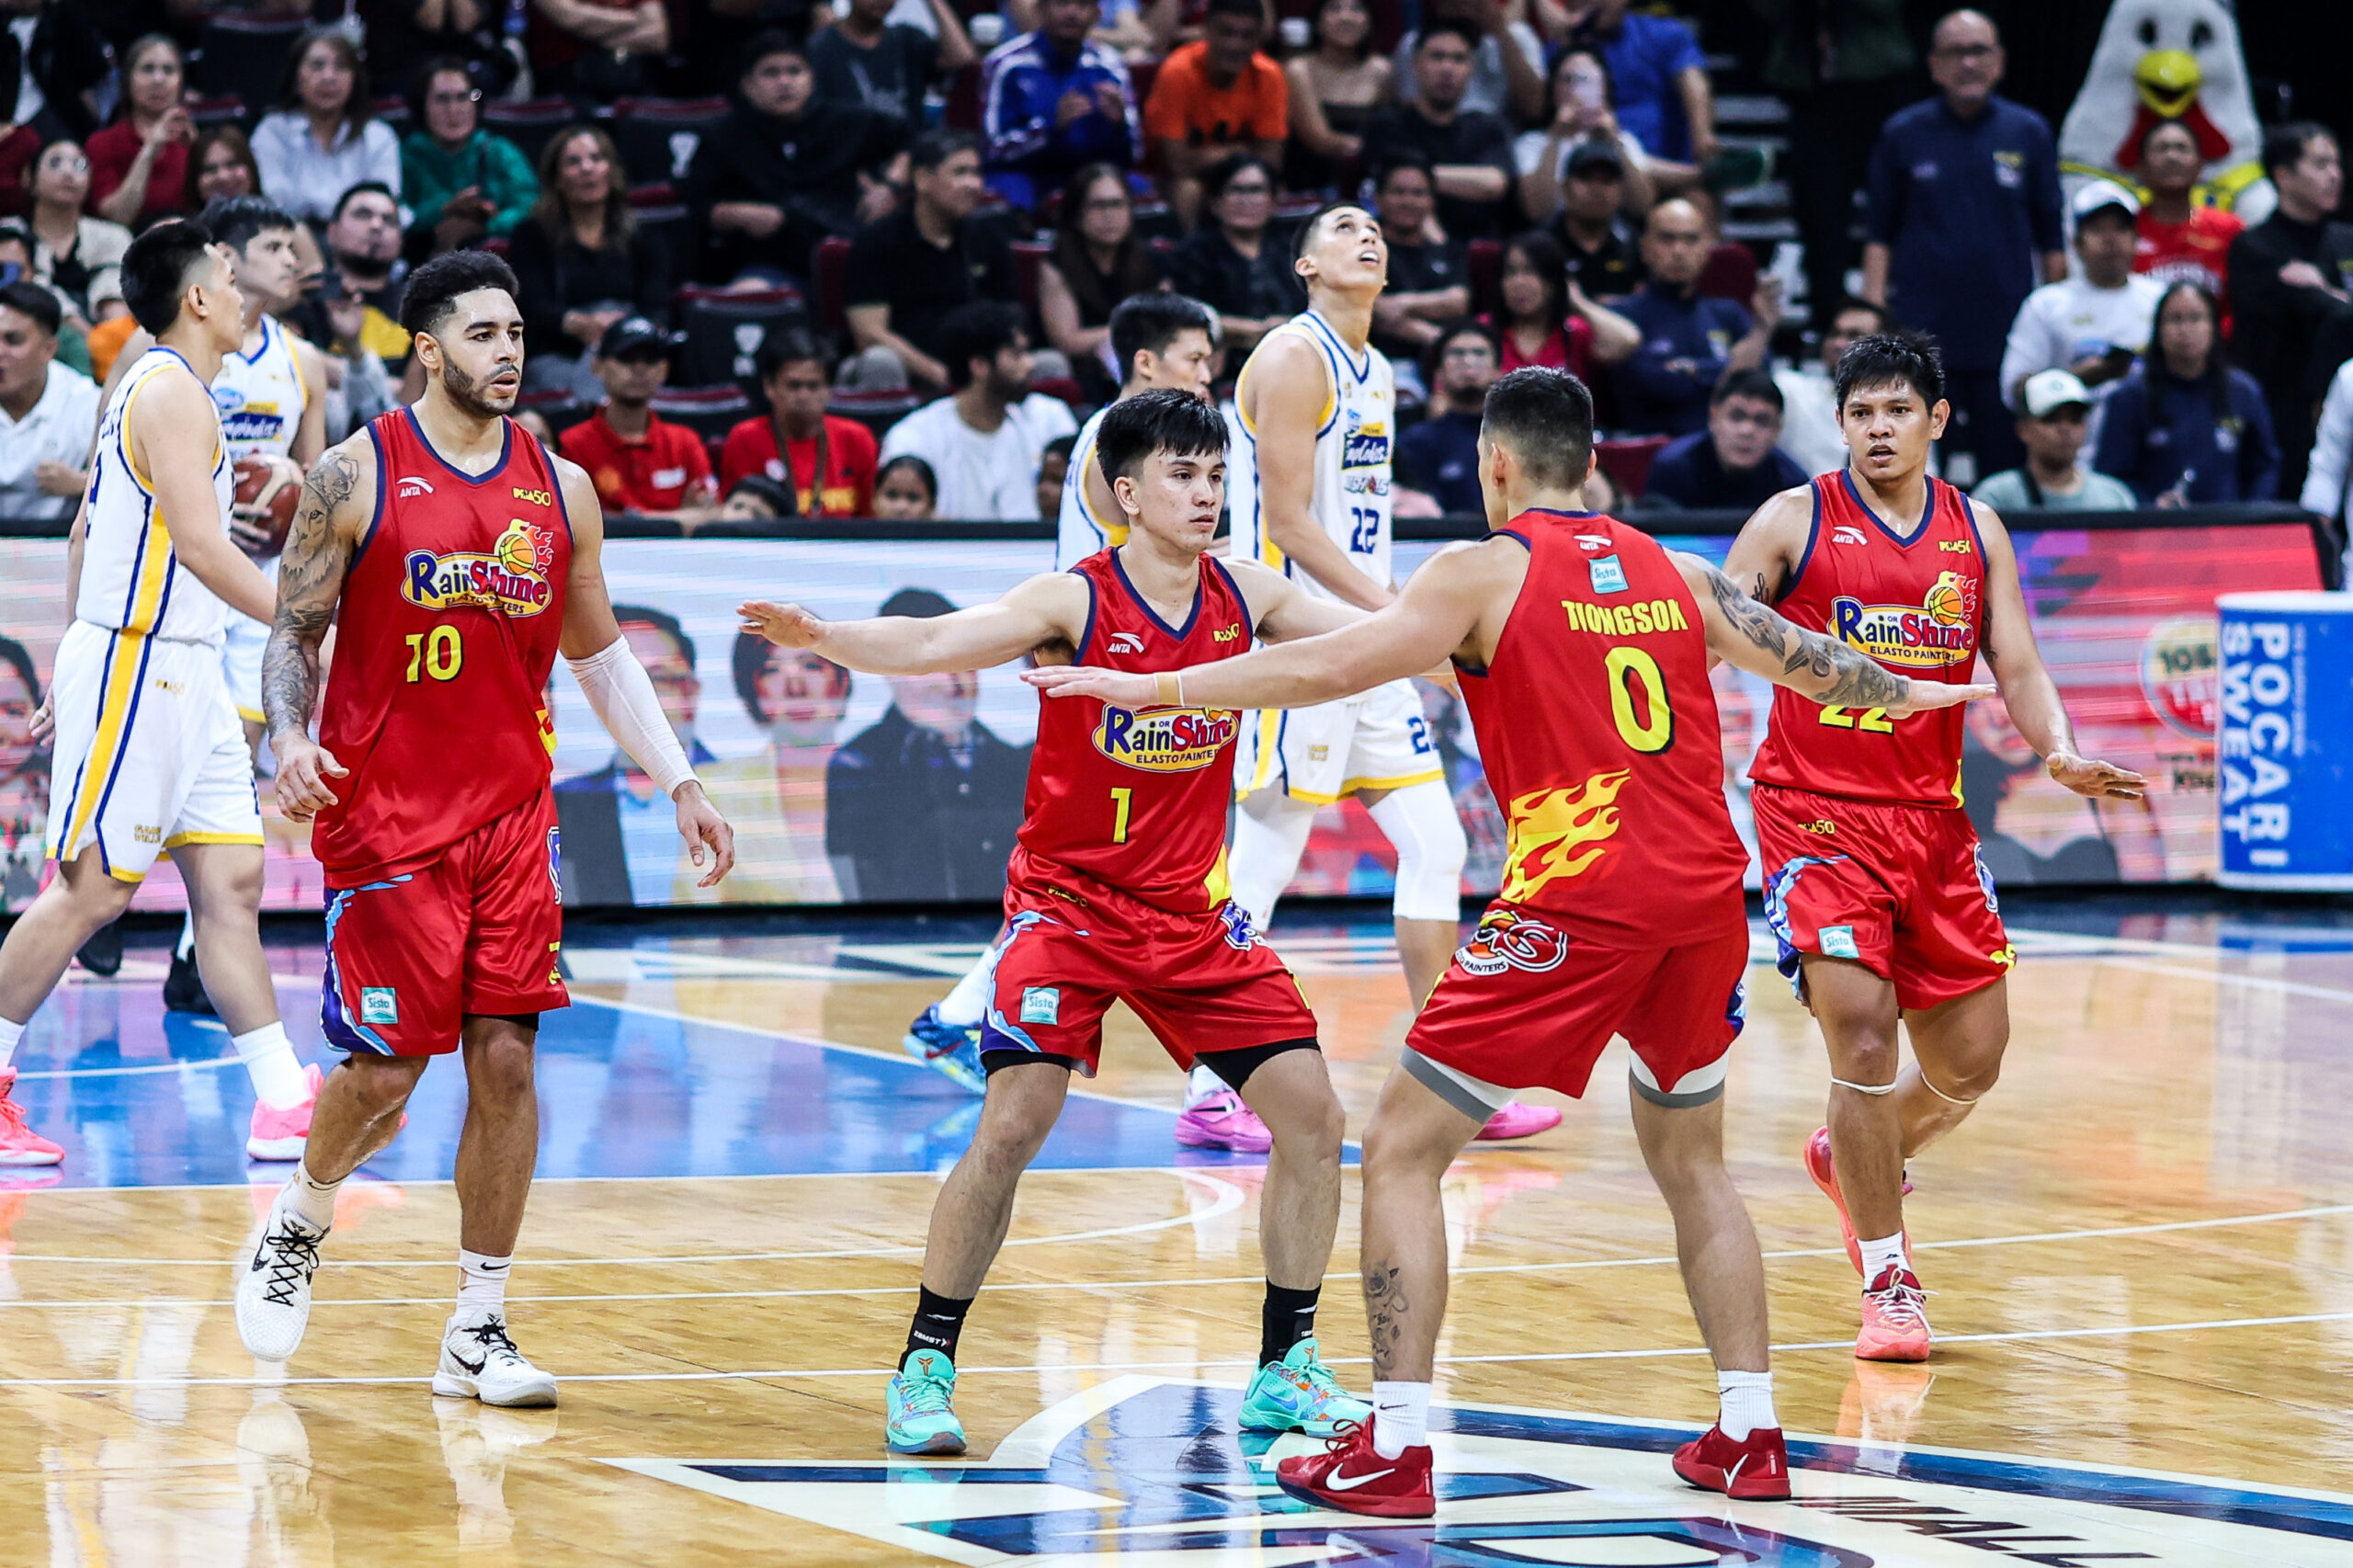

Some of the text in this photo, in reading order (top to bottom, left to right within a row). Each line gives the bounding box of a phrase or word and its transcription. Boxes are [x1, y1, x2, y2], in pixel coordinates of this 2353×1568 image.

[400, 486, 421, 498] ANTA
[1350, 506, 1380, 554] 22
[1579, 540, 1600, 551] ANTA
[1833, 533, 1855, 545] ANTA
[470, 560, 549, 607] Shine
[1836, 599, 1900, 644] Rain
[1900, 613, 1973, 651] Shine
[405, 624, 462, 683] 10
[1108, 642, 1131, 653] ANTA
[1870, 645, 1955, 662] ELASTO PAINTERS
[1604, 646, 1675, 755] 0
[1104, 704, 1170, 754] Rain
[2221, 620, 2251, 844] SWEAT
[2249, 621, 2290, 867] POCARI
[1136, 754, 1179, 764] ELASTO
[1110, 788, 1133, 844] 1
[1825, 936, 1849, 948] Sista
[1464, 960, 1506, 972] PAINTERS
[368, 996, 390, 1009] Sista
[1029, 995, 1053, 1008] Sista
